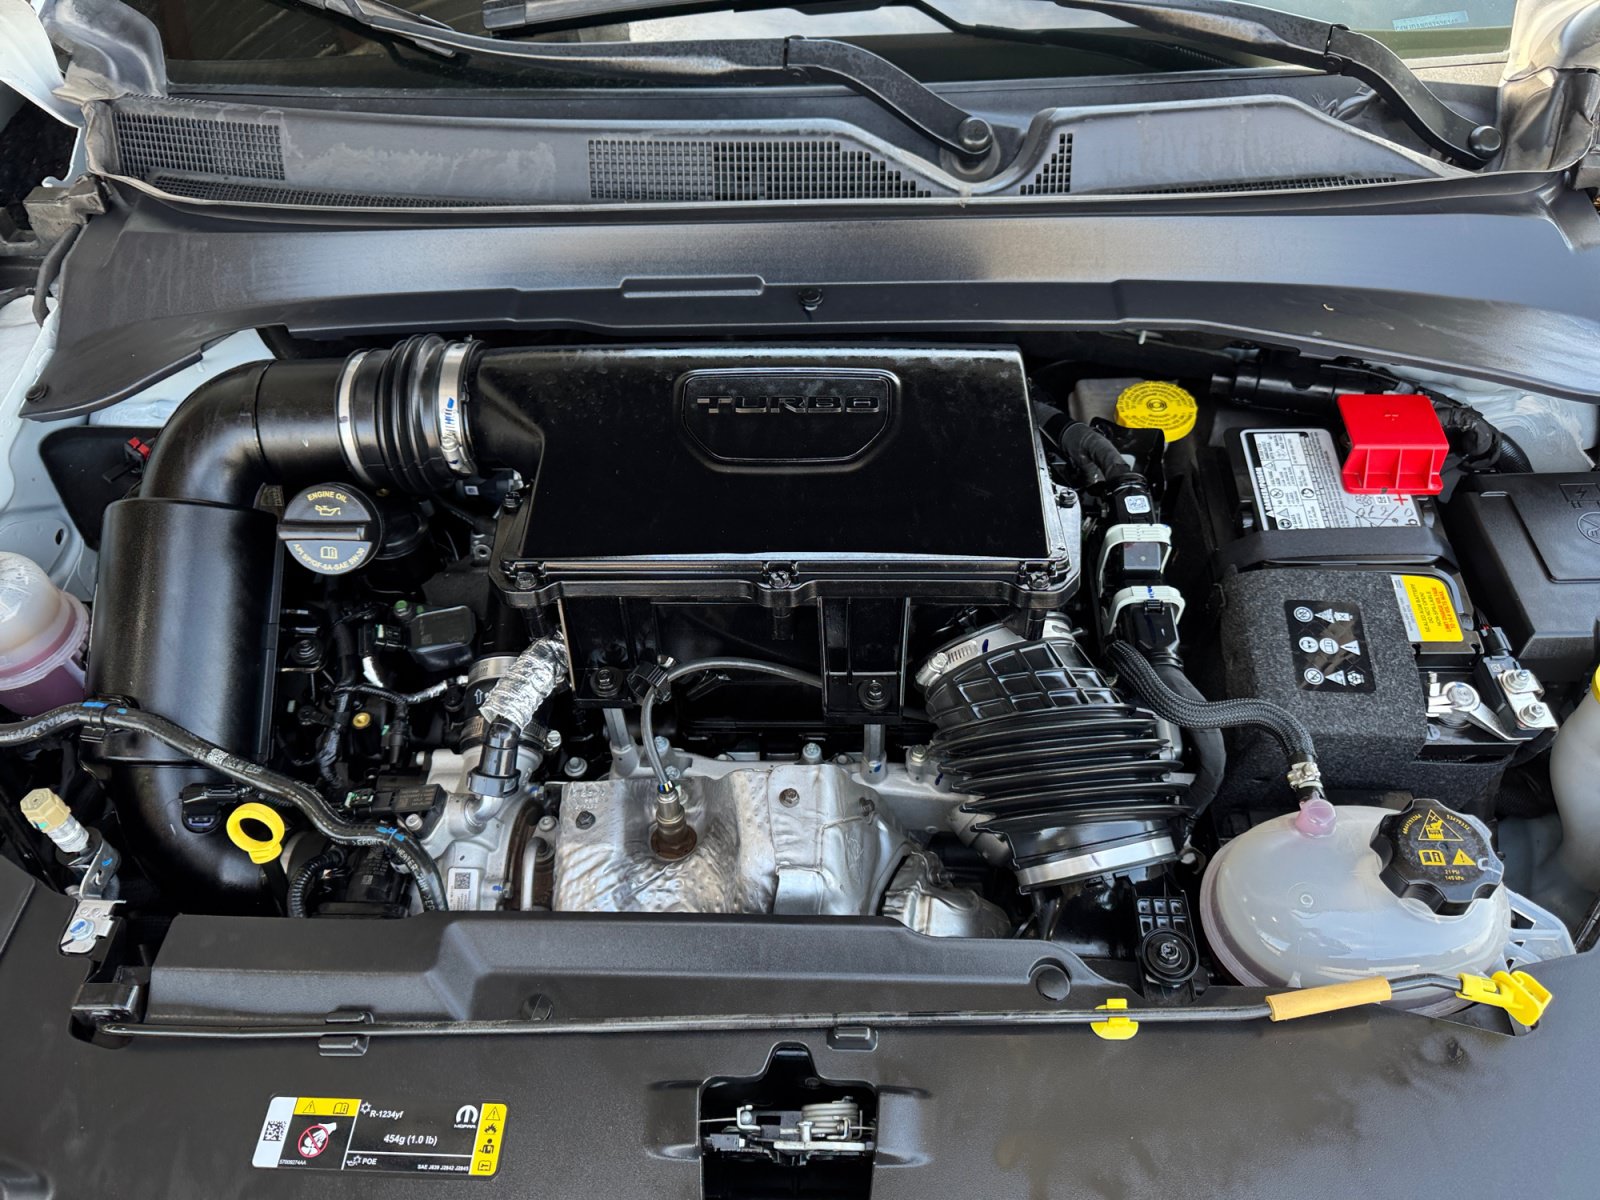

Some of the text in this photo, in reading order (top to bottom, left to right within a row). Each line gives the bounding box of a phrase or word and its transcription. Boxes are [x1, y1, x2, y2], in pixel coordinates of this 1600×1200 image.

[697, 396, 879, 413] TURBO
[307, 491, 348, 503] ENGINE OIL
[369, 1109, 404, 1120] R-1234yf
[383, 1134, 438, 1147] 454g (1.0 lb)
